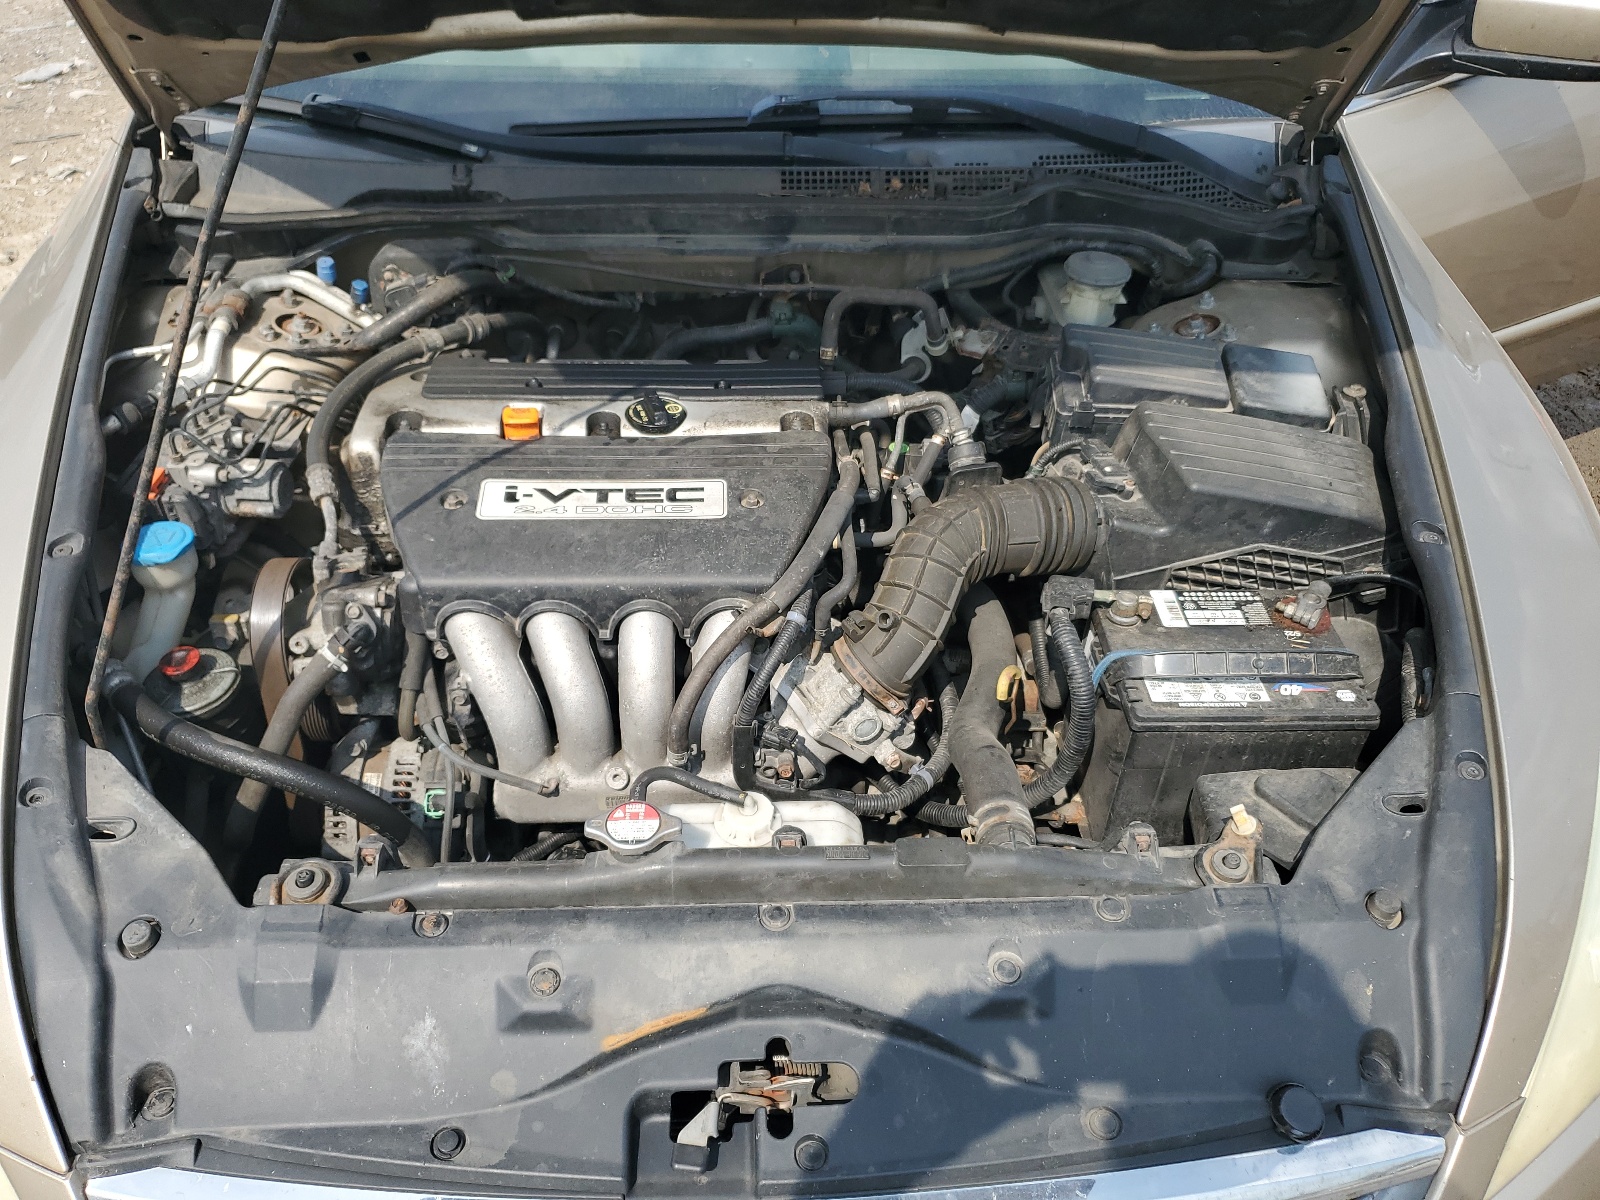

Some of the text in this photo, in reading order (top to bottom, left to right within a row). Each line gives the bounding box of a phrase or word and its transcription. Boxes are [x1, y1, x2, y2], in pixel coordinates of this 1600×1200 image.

[504, 485, 704, 504] i-VTEC
[514, 505, 693, 514] 2.4 DOHC
[1279, 684, 1303, 696] 40
